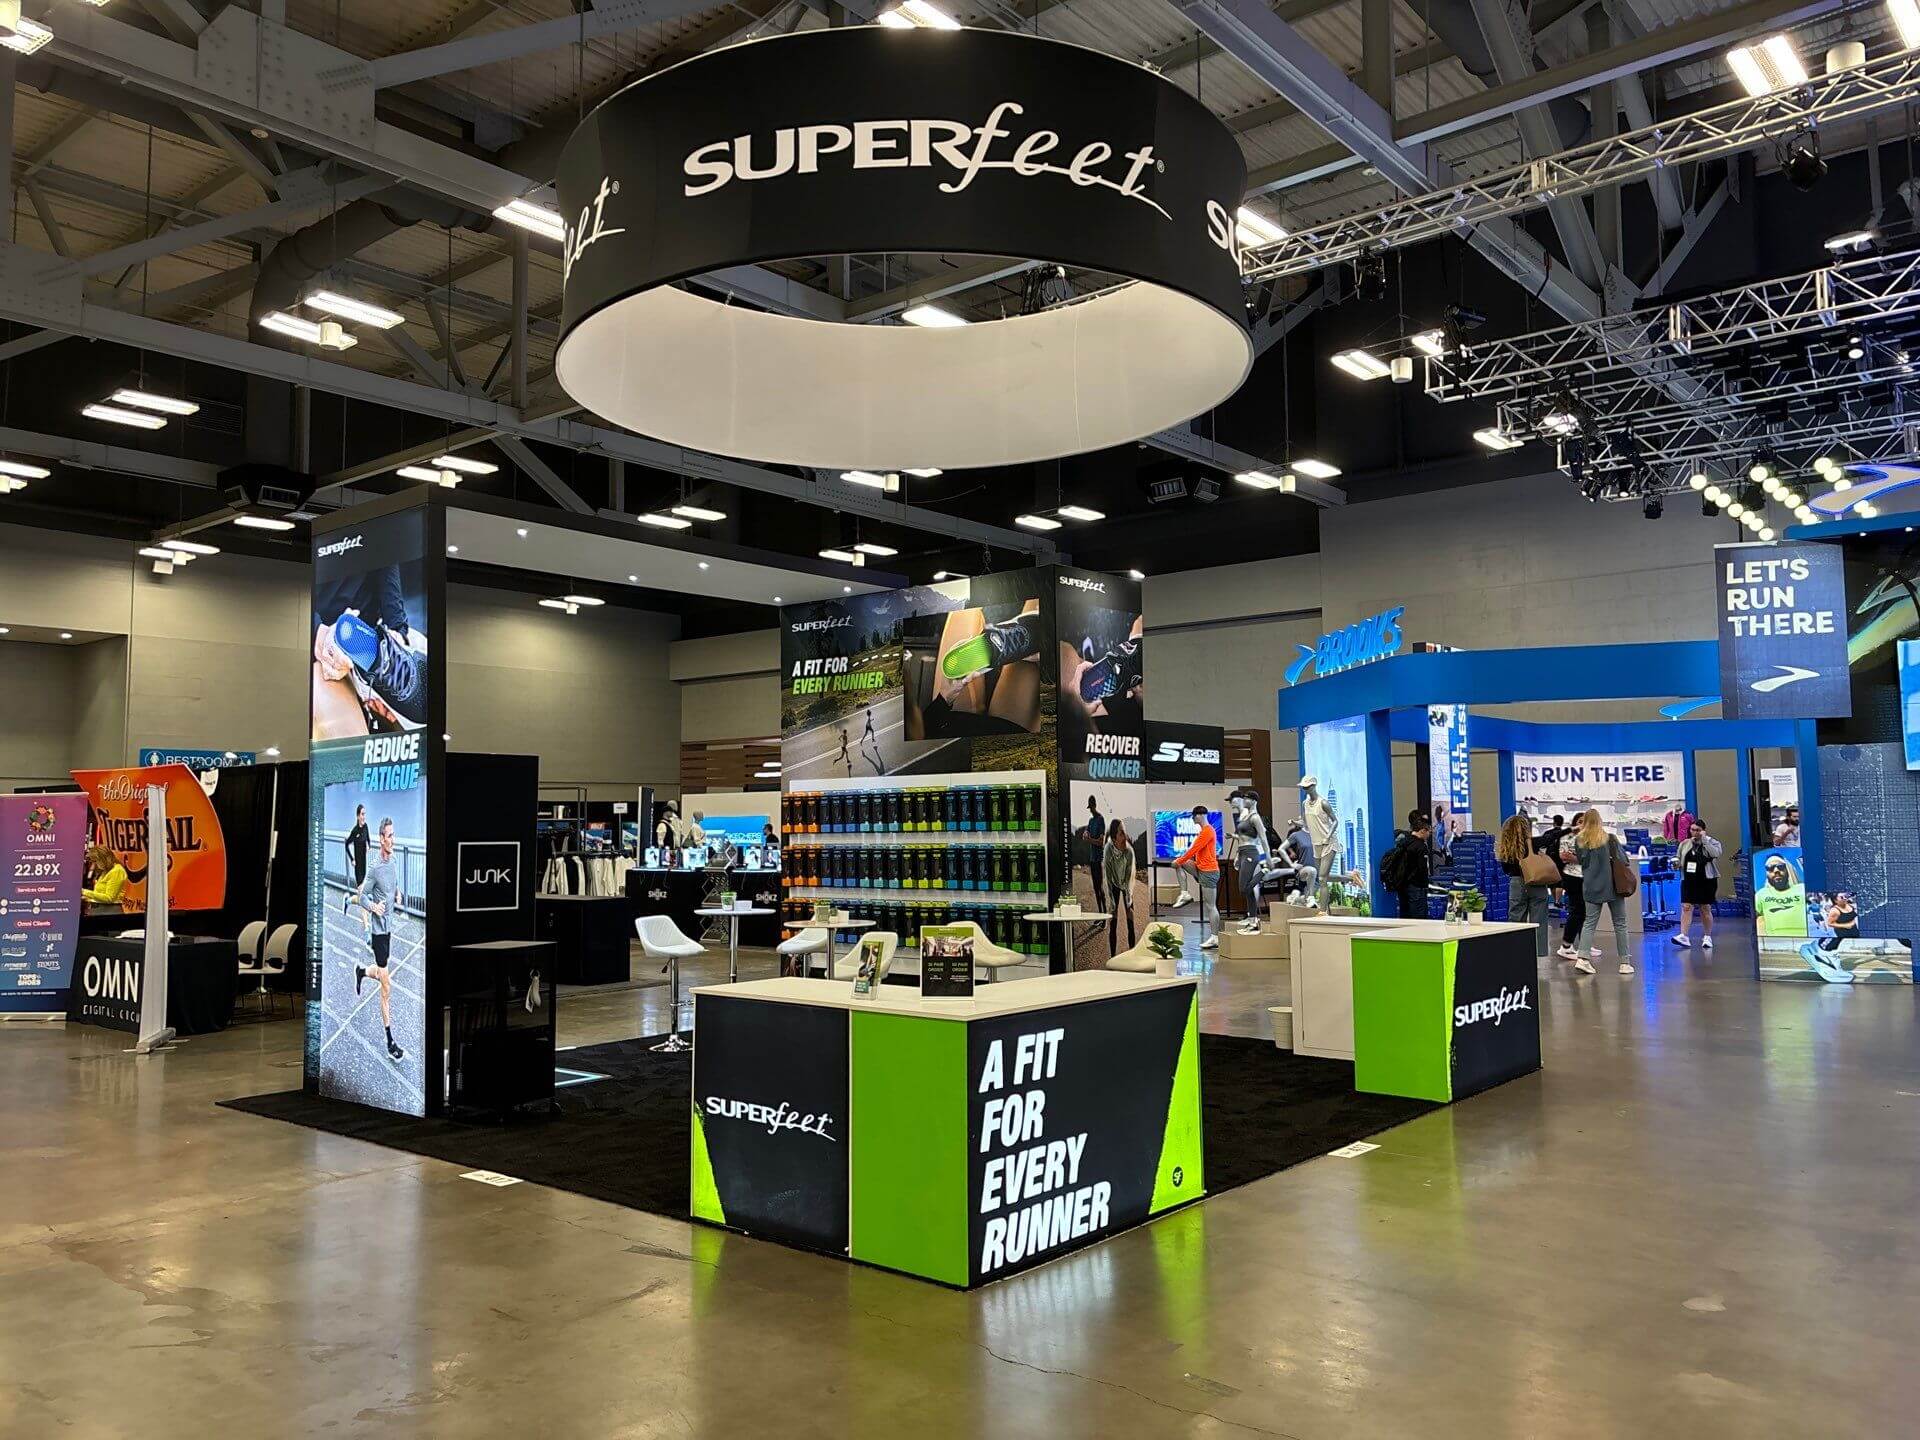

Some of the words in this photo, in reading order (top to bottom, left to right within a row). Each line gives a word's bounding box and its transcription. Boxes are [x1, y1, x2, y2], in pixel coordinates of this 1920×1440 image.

[317, 534, 363, 558] SUPERfeet
[1726, 558, 1810, 584] LET'S
[1059, 575, 1106, 594] SUPERfeet
[1726, 586, 1795, 612] RUN
[791, 614, 853, 633] SUPERfeet
[1727, 611, 1835, 637] THERE
[1315, 605, 1405, 676] BROOKS
[792, 661, 801, 677] A
[803, 658, 823, 676] FIT
[824, 656, 848, 674] FOR
[792, 676, 832, 695] EVERY
[832, 671, 884, 692] RUNNER
[363, 733, 420, 764] REDUCE
[1085, 733, 1140, 756] RECOVER
[361, 762, 420, 793] FATIGUE
[1088, 757, 1141, 779] QUICKER
[1451, 743, 1461, 808] FEEL
[1515, 766, 1538, 783] LET'S
[1541, 767, 1584, 783] RUN
[1590, 765, 1665, 783] THERE
[26, 834, 56, 843] OMNI
[14, 863, 61, 876] 22.89X
[465, 868, 512, 884] JUNK
[83, 955, 140, 1003] OMN
[1455, 985, 1532, 1027] SUPERfeet
[978, 1040, 1003, 1093] A
[1013, 1027, 1065, 1081] FIT
[705, 1096, 836, 1141] SUPERfeet
[979, 1089, 1046, 1152] FOR
[980, 1132, 1089, 1214] EVERY
[980, 1181, 1112, 1274] RUNNER
